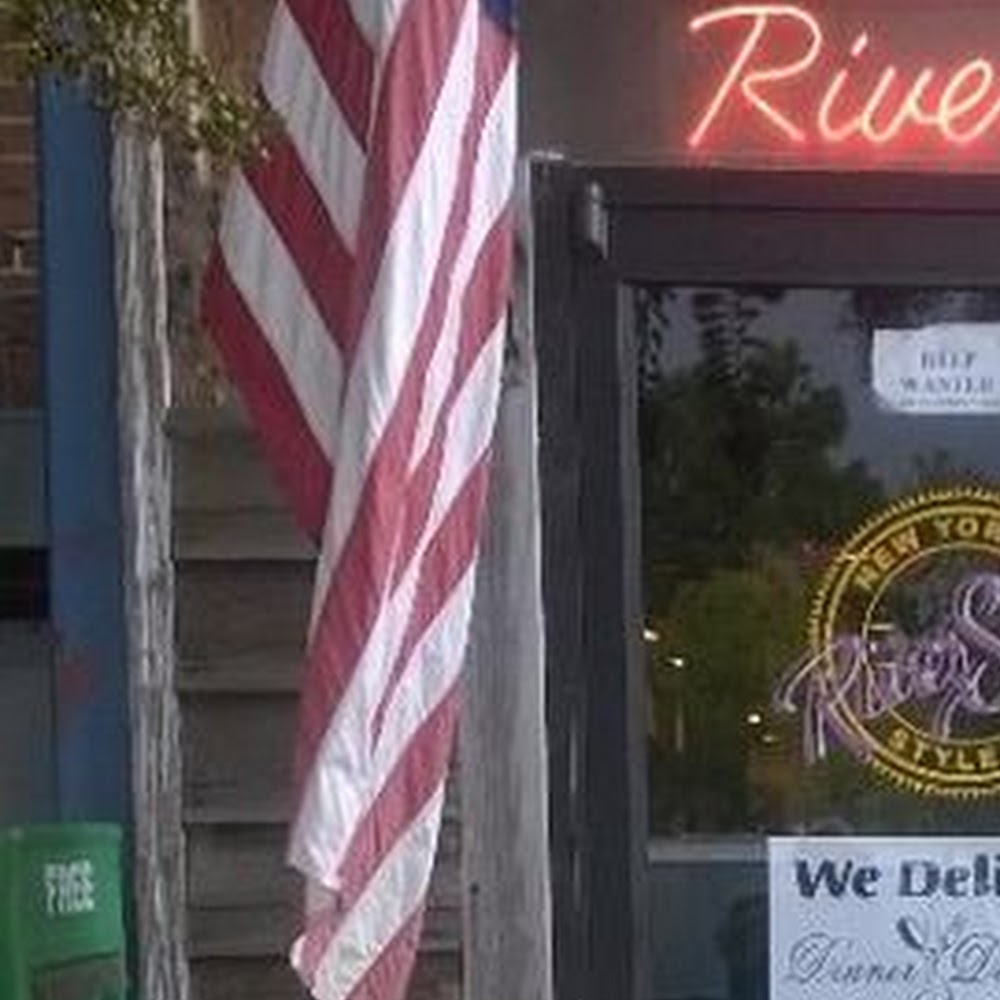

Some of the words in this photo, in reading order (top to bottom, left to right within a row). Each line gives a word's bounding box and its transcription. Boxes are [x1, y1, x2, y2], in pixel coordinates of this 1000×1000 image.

[855, 527, 921, 592] NEW
[887, 722, 998, 771] STYLE
[794, 858, 882, 899] We
